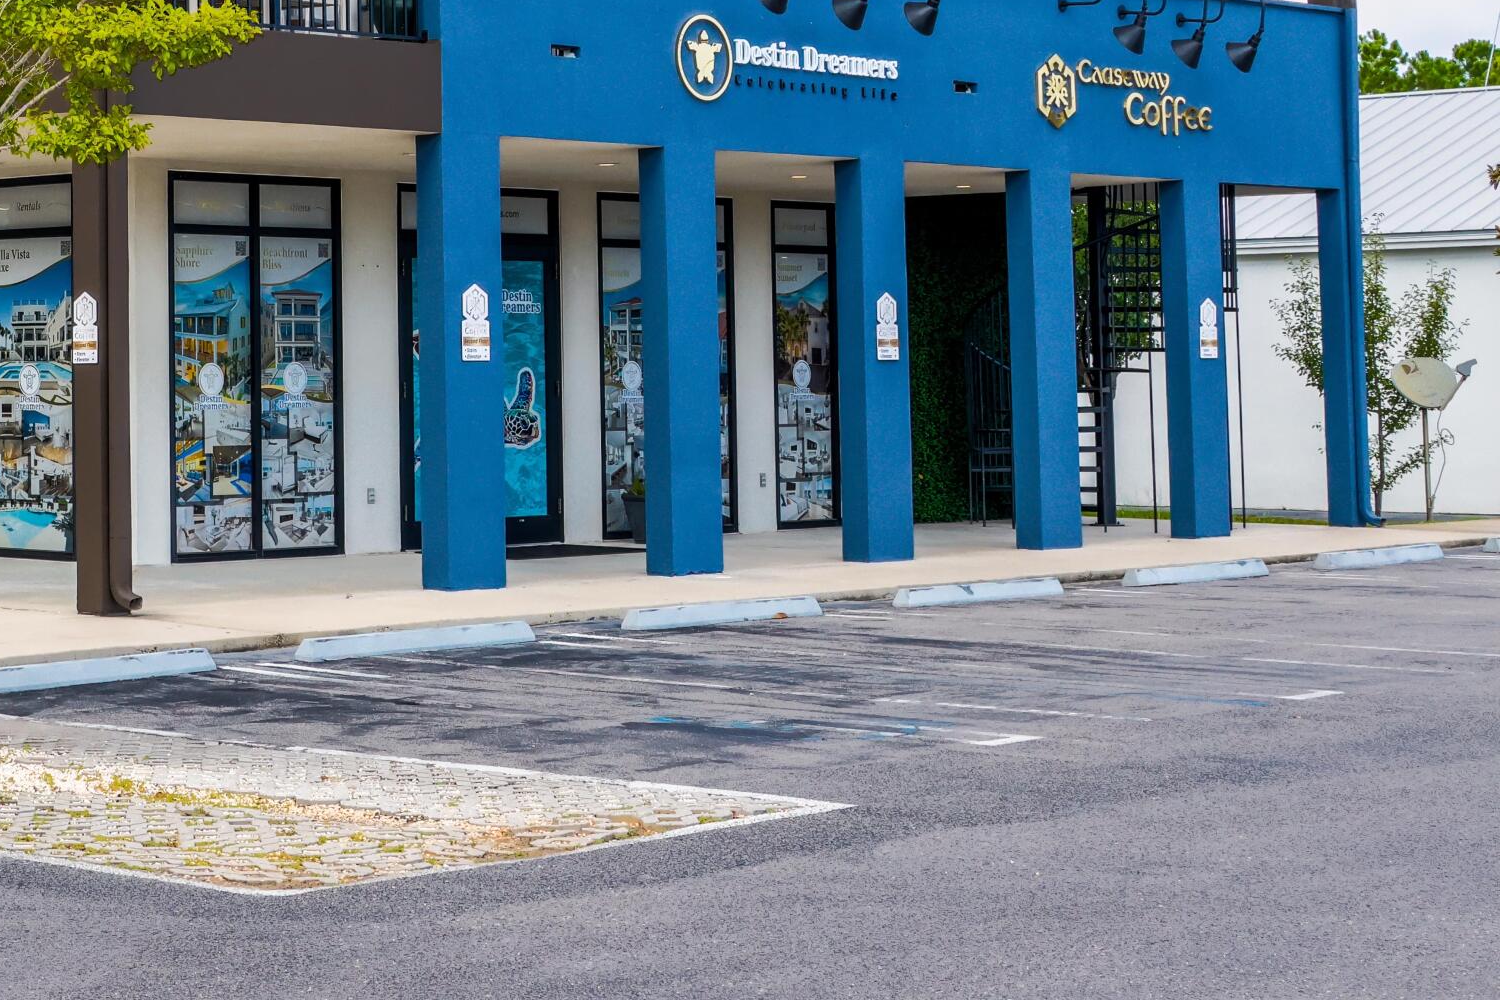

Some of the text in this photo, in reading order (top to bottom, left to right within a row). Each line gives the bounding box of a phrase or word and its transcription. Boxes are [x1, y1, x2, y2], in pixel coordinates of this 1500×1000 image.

[733, 38, 899, 80] Destin Dreamers
[734, 74, 899, 101] Celebrating Life
[1124, 91, 1214, 136] Coffee
[11, 249, 30, 260] Vista
[262, 248, 308, 259] Beachfront
[175, 258, 200, 268] Shore
[262, 259, 282, 270] Bliss
[502, 289, 532, 302] Destin
[502, 302, 541, 313] reamers
